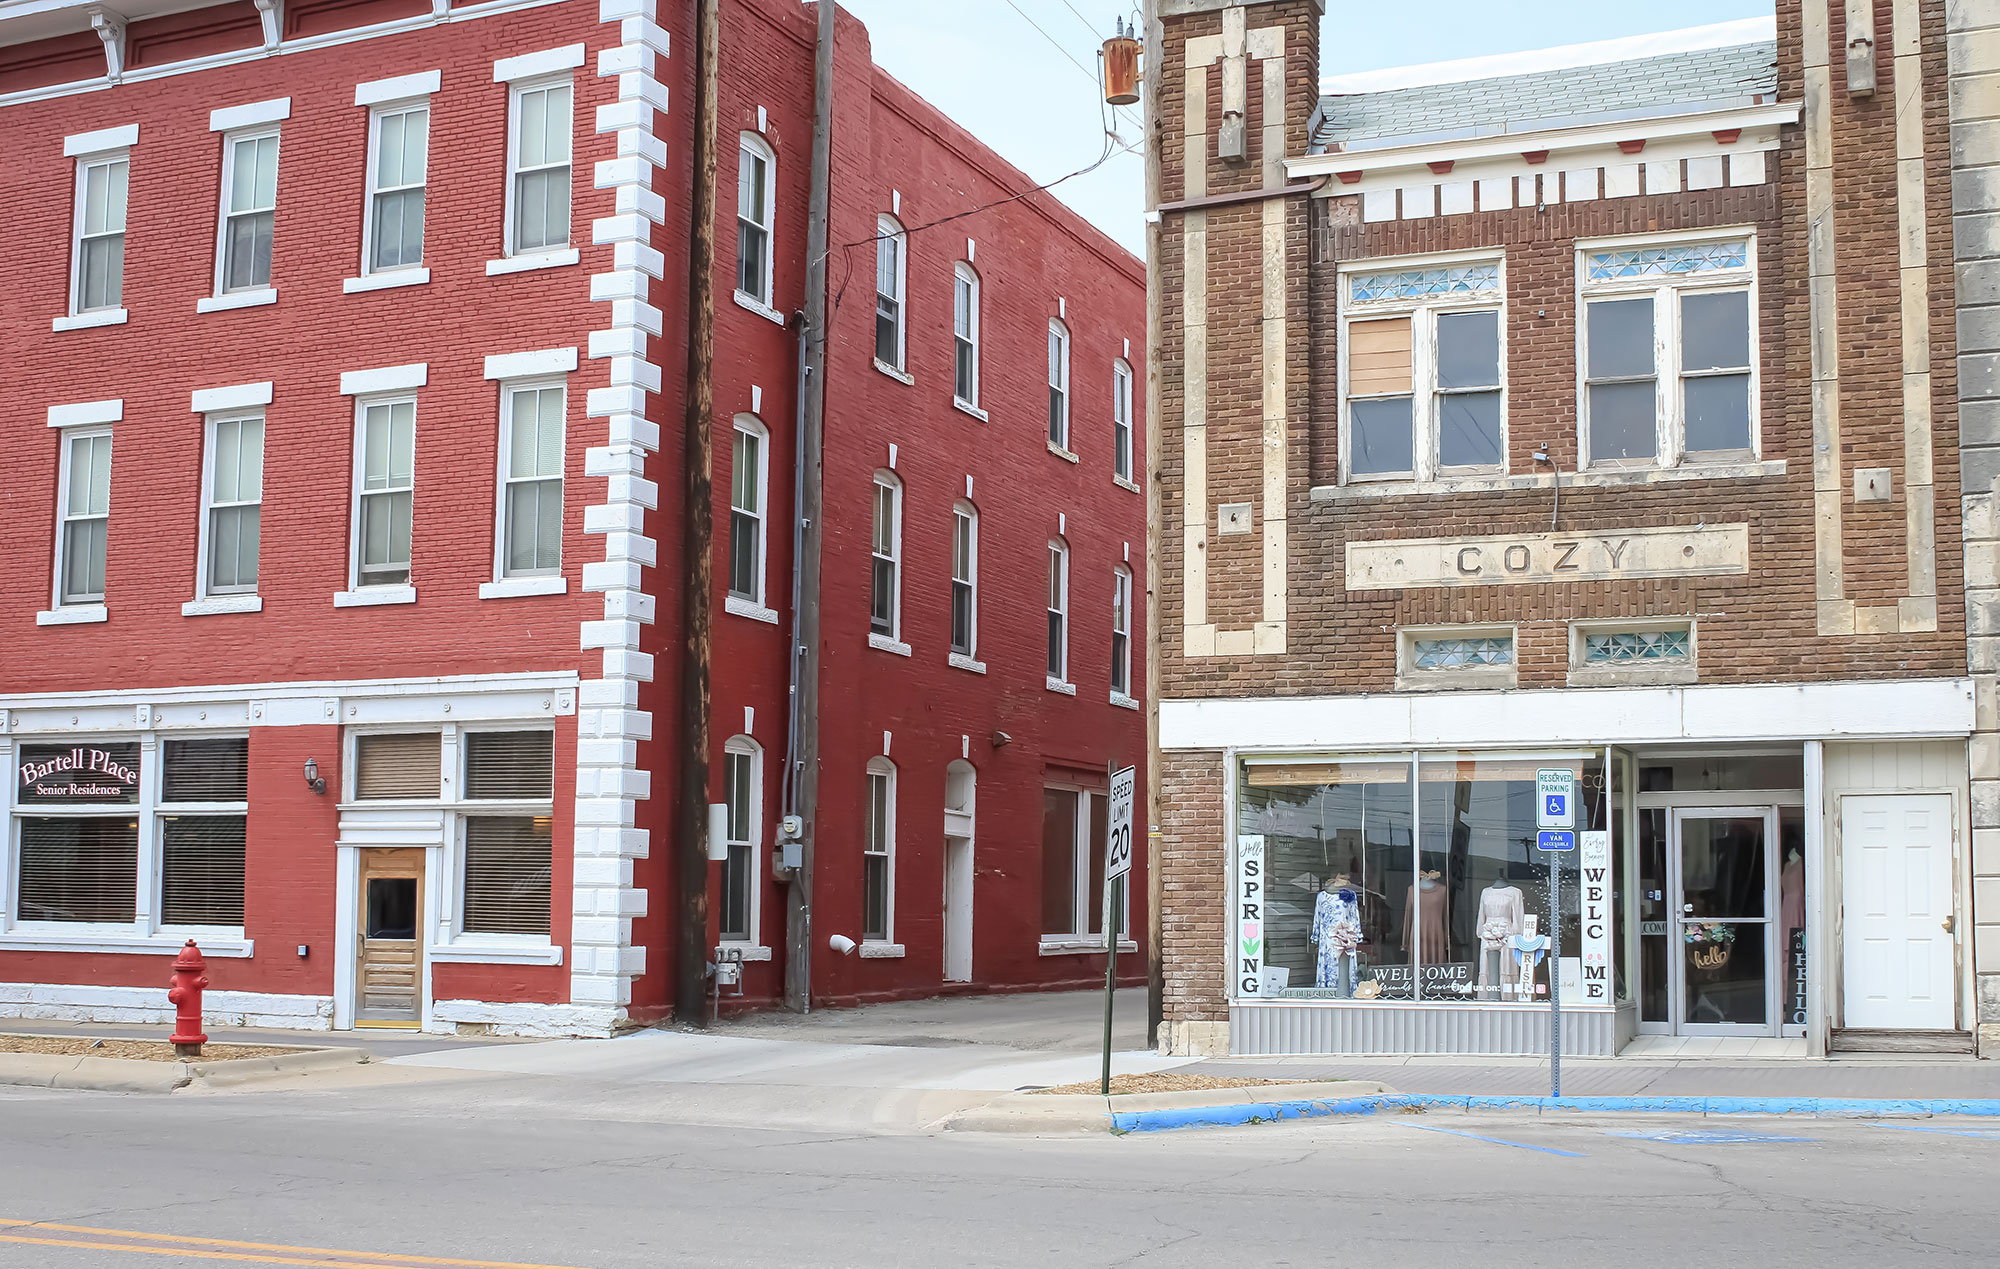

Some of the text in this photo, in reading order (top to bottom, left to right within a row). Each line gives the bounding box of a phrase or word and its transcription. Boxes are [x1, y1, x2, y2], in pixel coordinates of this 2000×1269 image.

[1457, 539, 1630, 576] COZY
[20, 748, 137, 785] Bartell Place
[37, 783, 121, 795] Senior Residences
[1540, 774, 1572, 783] RESERVED
[1541, 784, 1569, 793] PARKING
[1112, 780, 1132, 802] SPEED
[1113, 802, 1130, 823] LIMIT
[1110, 823, 1130, 867] 20
[1549, 834, 1563, 842] VAN
[1242, 860, 1260, 993] SPRNG
[1525, 920, 1536, 930] HE
[1584, 868, 1606, 998] WELCME
[1694, 946, 1727, 969] hello
[1373, 966, 1467, 981] WELCOME
[1473, 984, 1484, 992] us
[1486, 984, 1500, 992] on:
